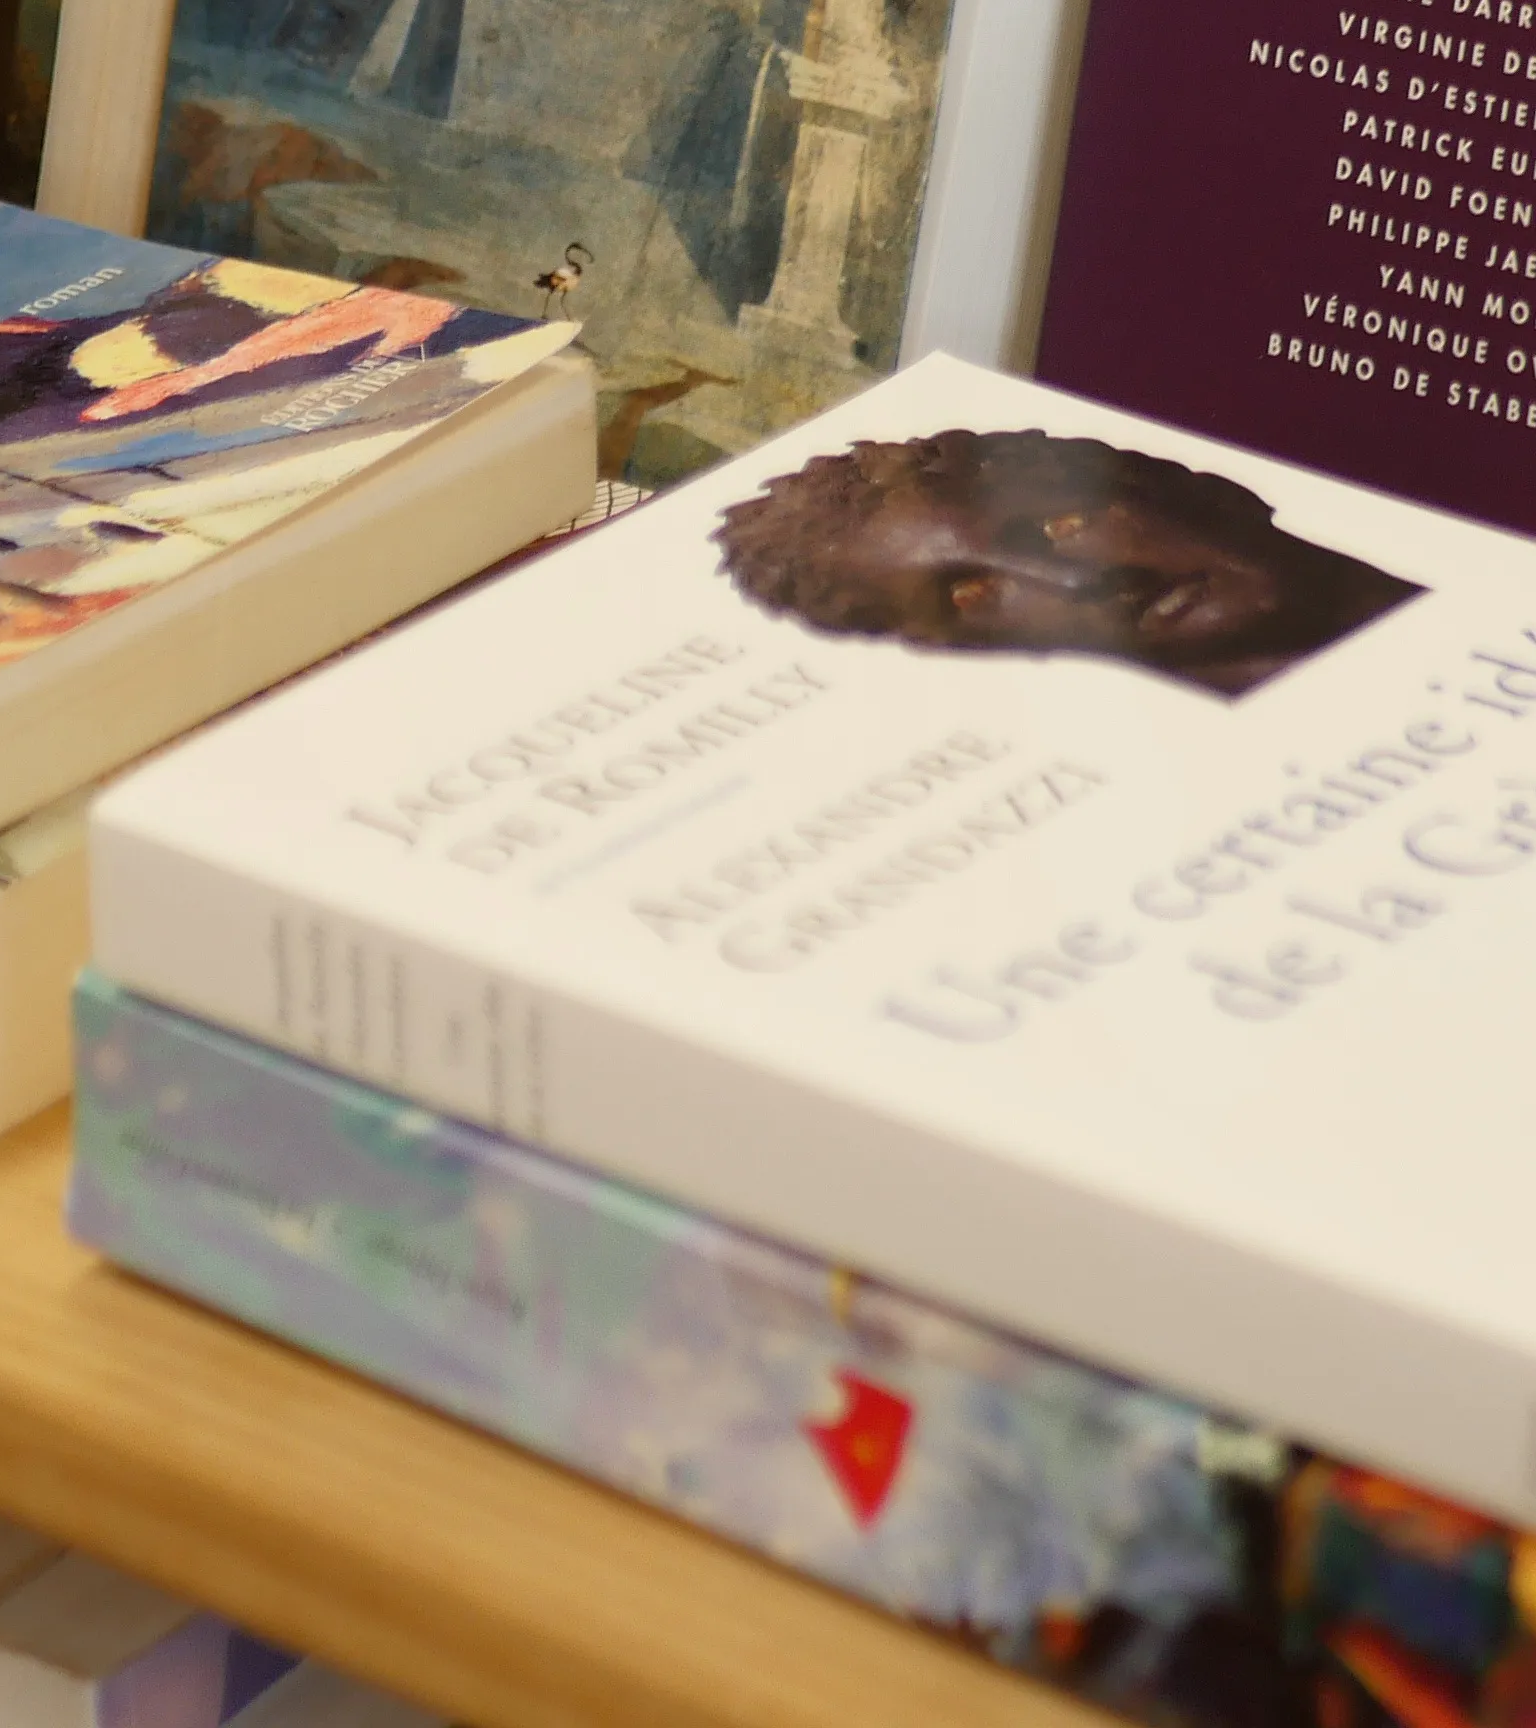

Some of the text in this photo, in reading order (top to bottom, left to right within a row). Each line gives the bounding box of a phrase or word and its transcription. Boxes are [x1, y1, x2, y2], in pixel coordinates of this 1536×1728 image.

[1249, 39, 1392, 95] NICOLAS
[1337, 11, 1488, 68] VIRGINIE
[1342, 109, 1476, 164] PATRICK
[1335, 156, 1435, 204] DAVID
[1326, 202, 1471, 263] PHILIPPE
[18, 262, 123, 319] roman
[1377, 263, 1466, 311] YANN
[1302, 292, 1491, 368] VÉRONIQUE
[1267, 332, 1377, 383] BRUNO
[1391, 365, 1431, 399] DE
[876, 906, 1143, 1049] Une
[1131, 684, 1479, 926] certaine
[1187, 923, 1350, 1026] de
[1284, 856, 1445, 946] la
